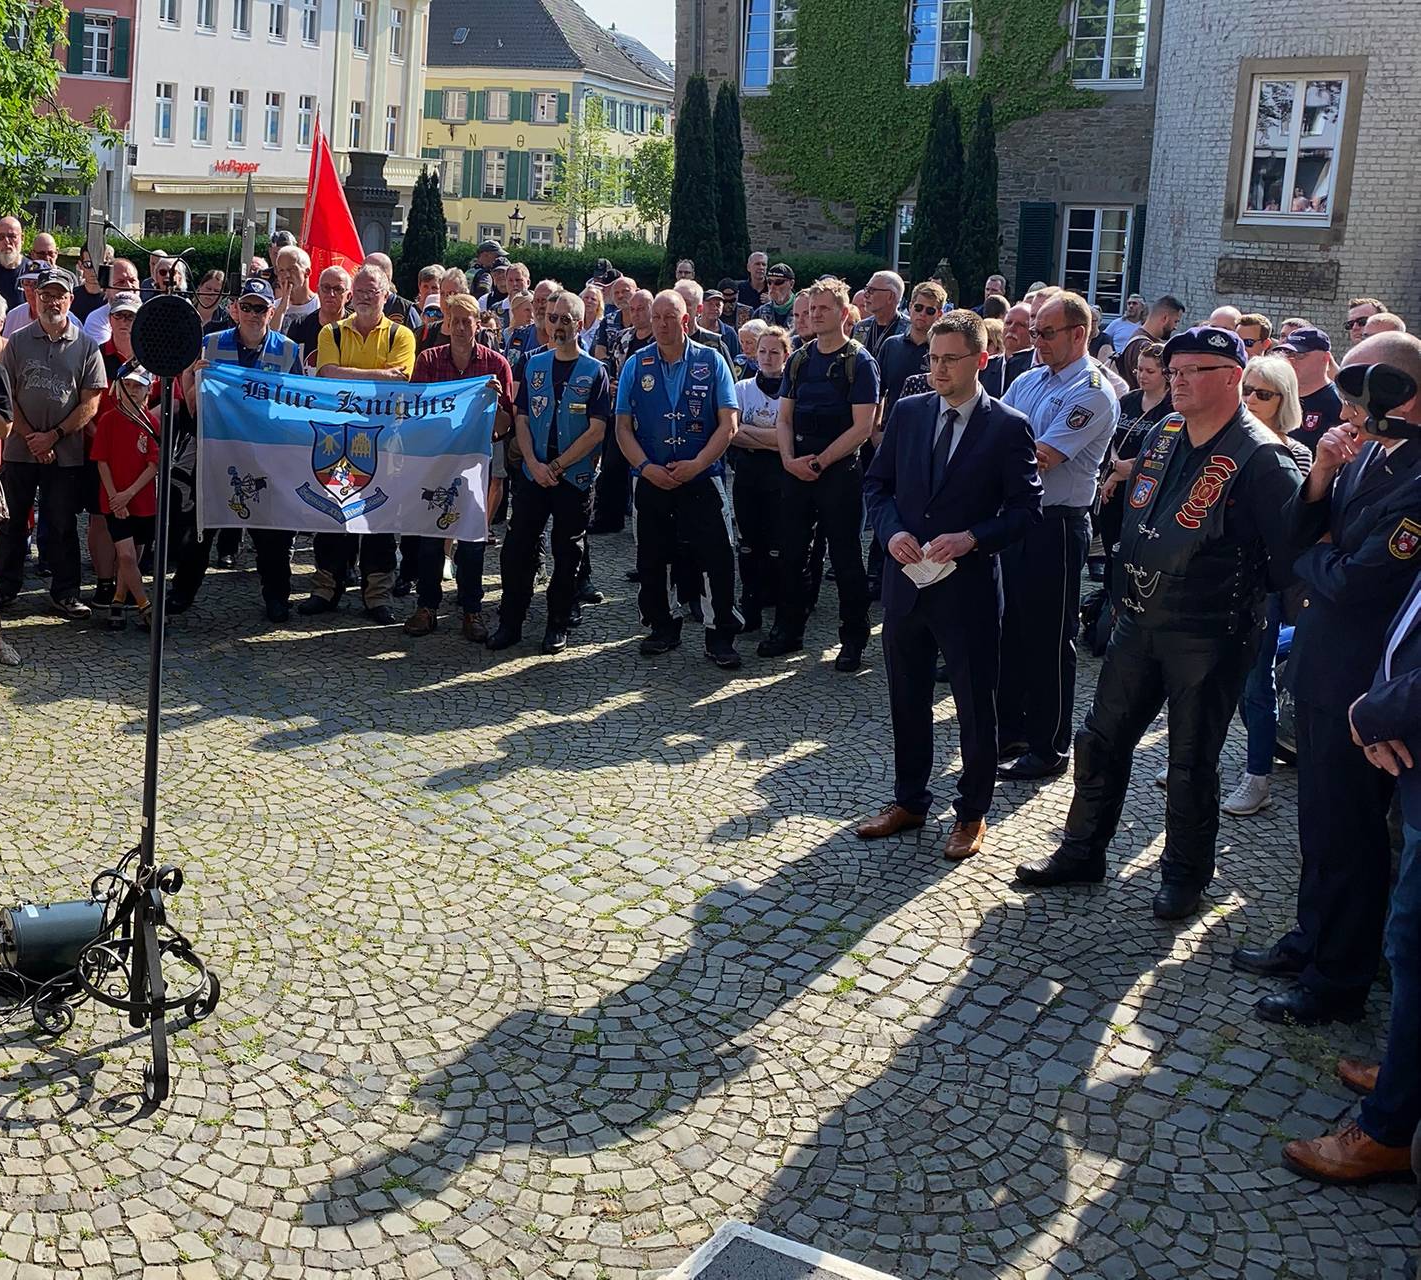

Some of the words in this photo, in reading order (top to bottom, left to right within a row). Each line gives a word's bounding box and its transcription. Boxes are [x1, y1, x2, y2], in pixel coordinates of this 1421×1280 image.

[214, 159, 260, 179] McPaper
[241, 378, 319, 410] Blue
[335, 387, 458, 421] Knights
